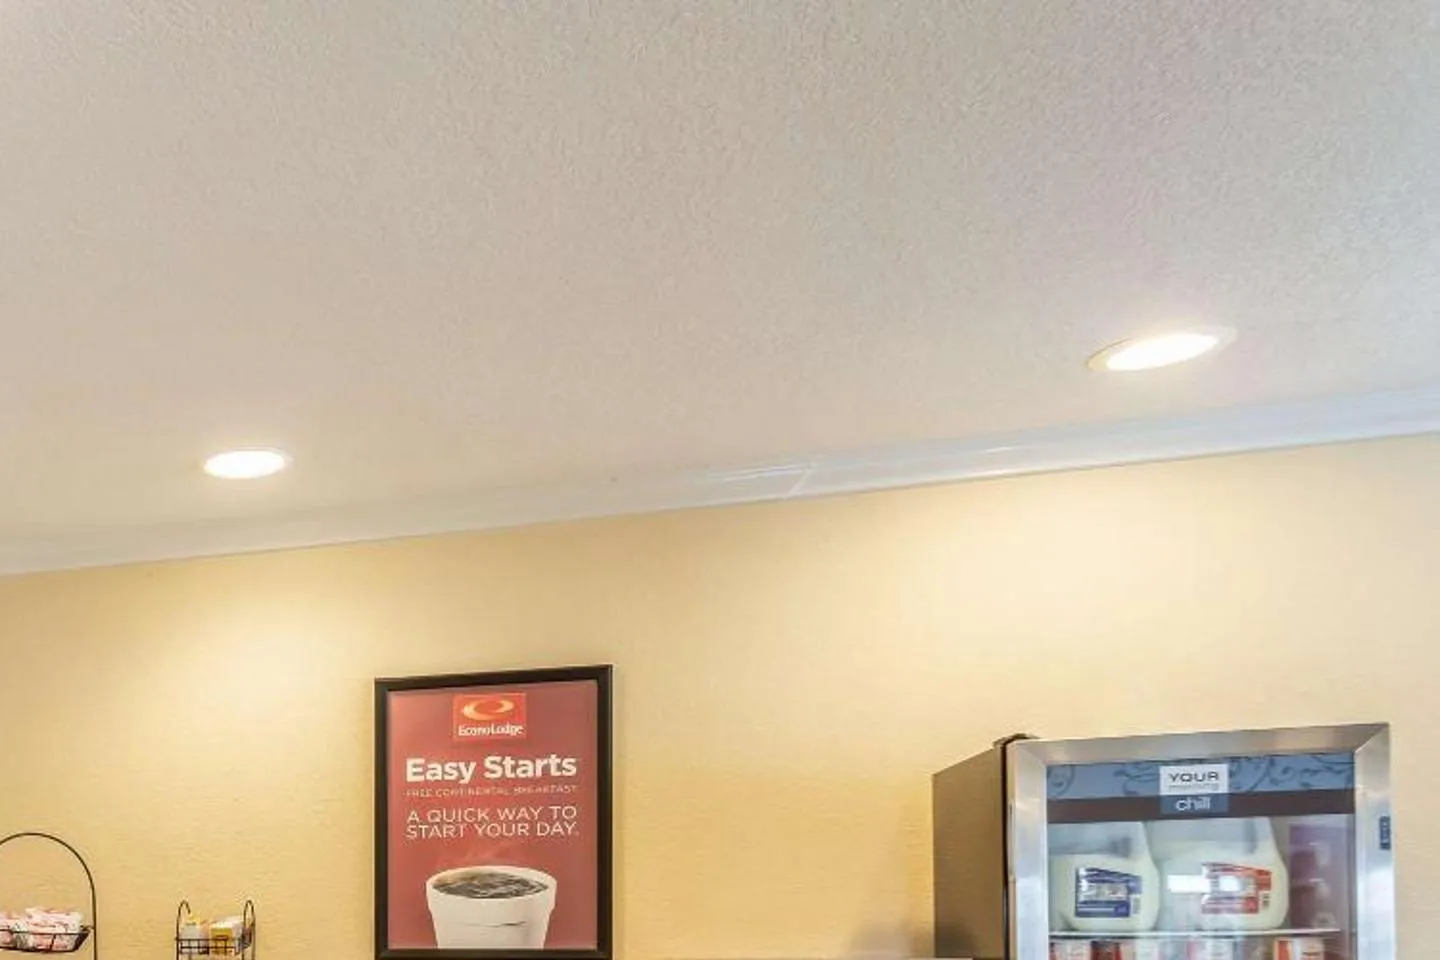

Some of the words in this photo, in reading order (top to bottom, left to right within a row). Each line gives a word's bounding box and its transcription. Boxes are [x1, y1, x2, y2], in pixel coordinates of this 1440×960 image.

[406, 758, 477, 785] Easy
[484, 754, 577, 779] Starts
[1167, 771, 1219, 782] YOUR
[406, 788, 433, 798] FREE
[435, 786, 510, 798] CONTINENTAL
[407, 809, 420, 824] A
[427, 806, 491, 824] QUICK
[496, 805, 545, 821] WAY
[549, 805, 578, 820] TO
[406, 823, 465, 840] START
[474, 822, 530, 839] YOUR
